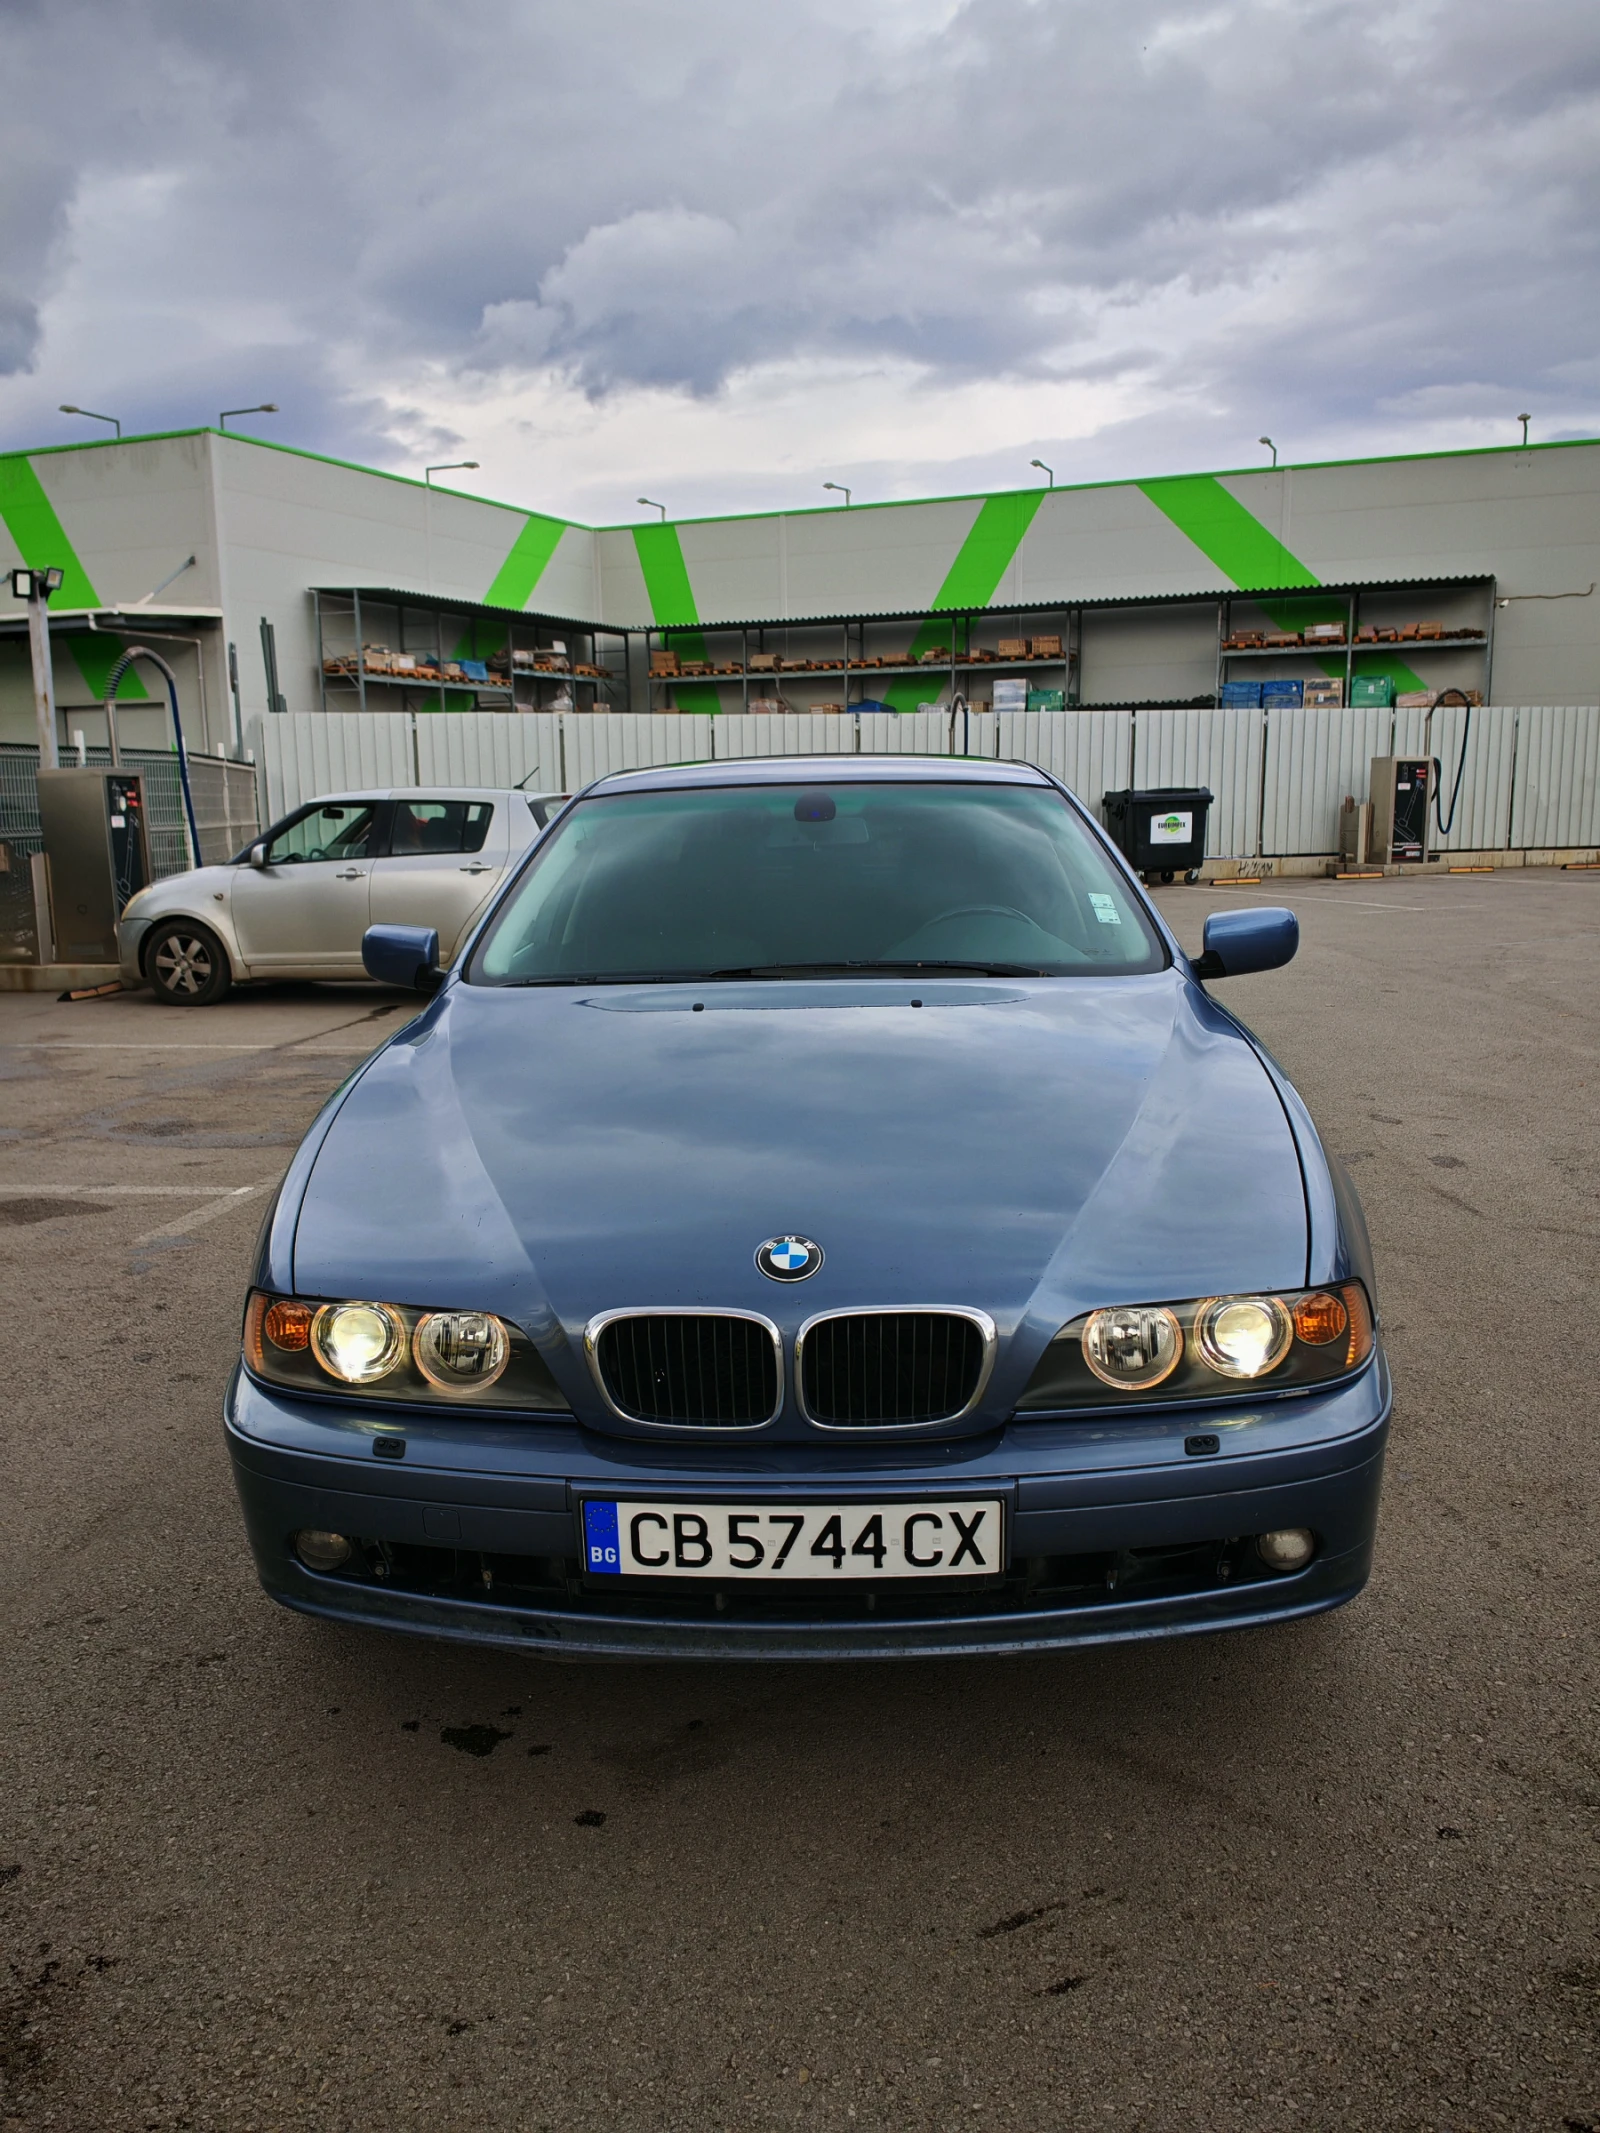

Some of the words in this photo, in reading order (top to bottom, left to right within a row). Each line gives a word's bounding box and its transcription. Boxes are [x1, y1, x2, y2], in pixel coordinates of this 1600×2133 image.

[764, 1236, 816, 1250] BMW
[728, 1514, 887, 1570] 5744
[590, 1546, 617, 1564] BG
